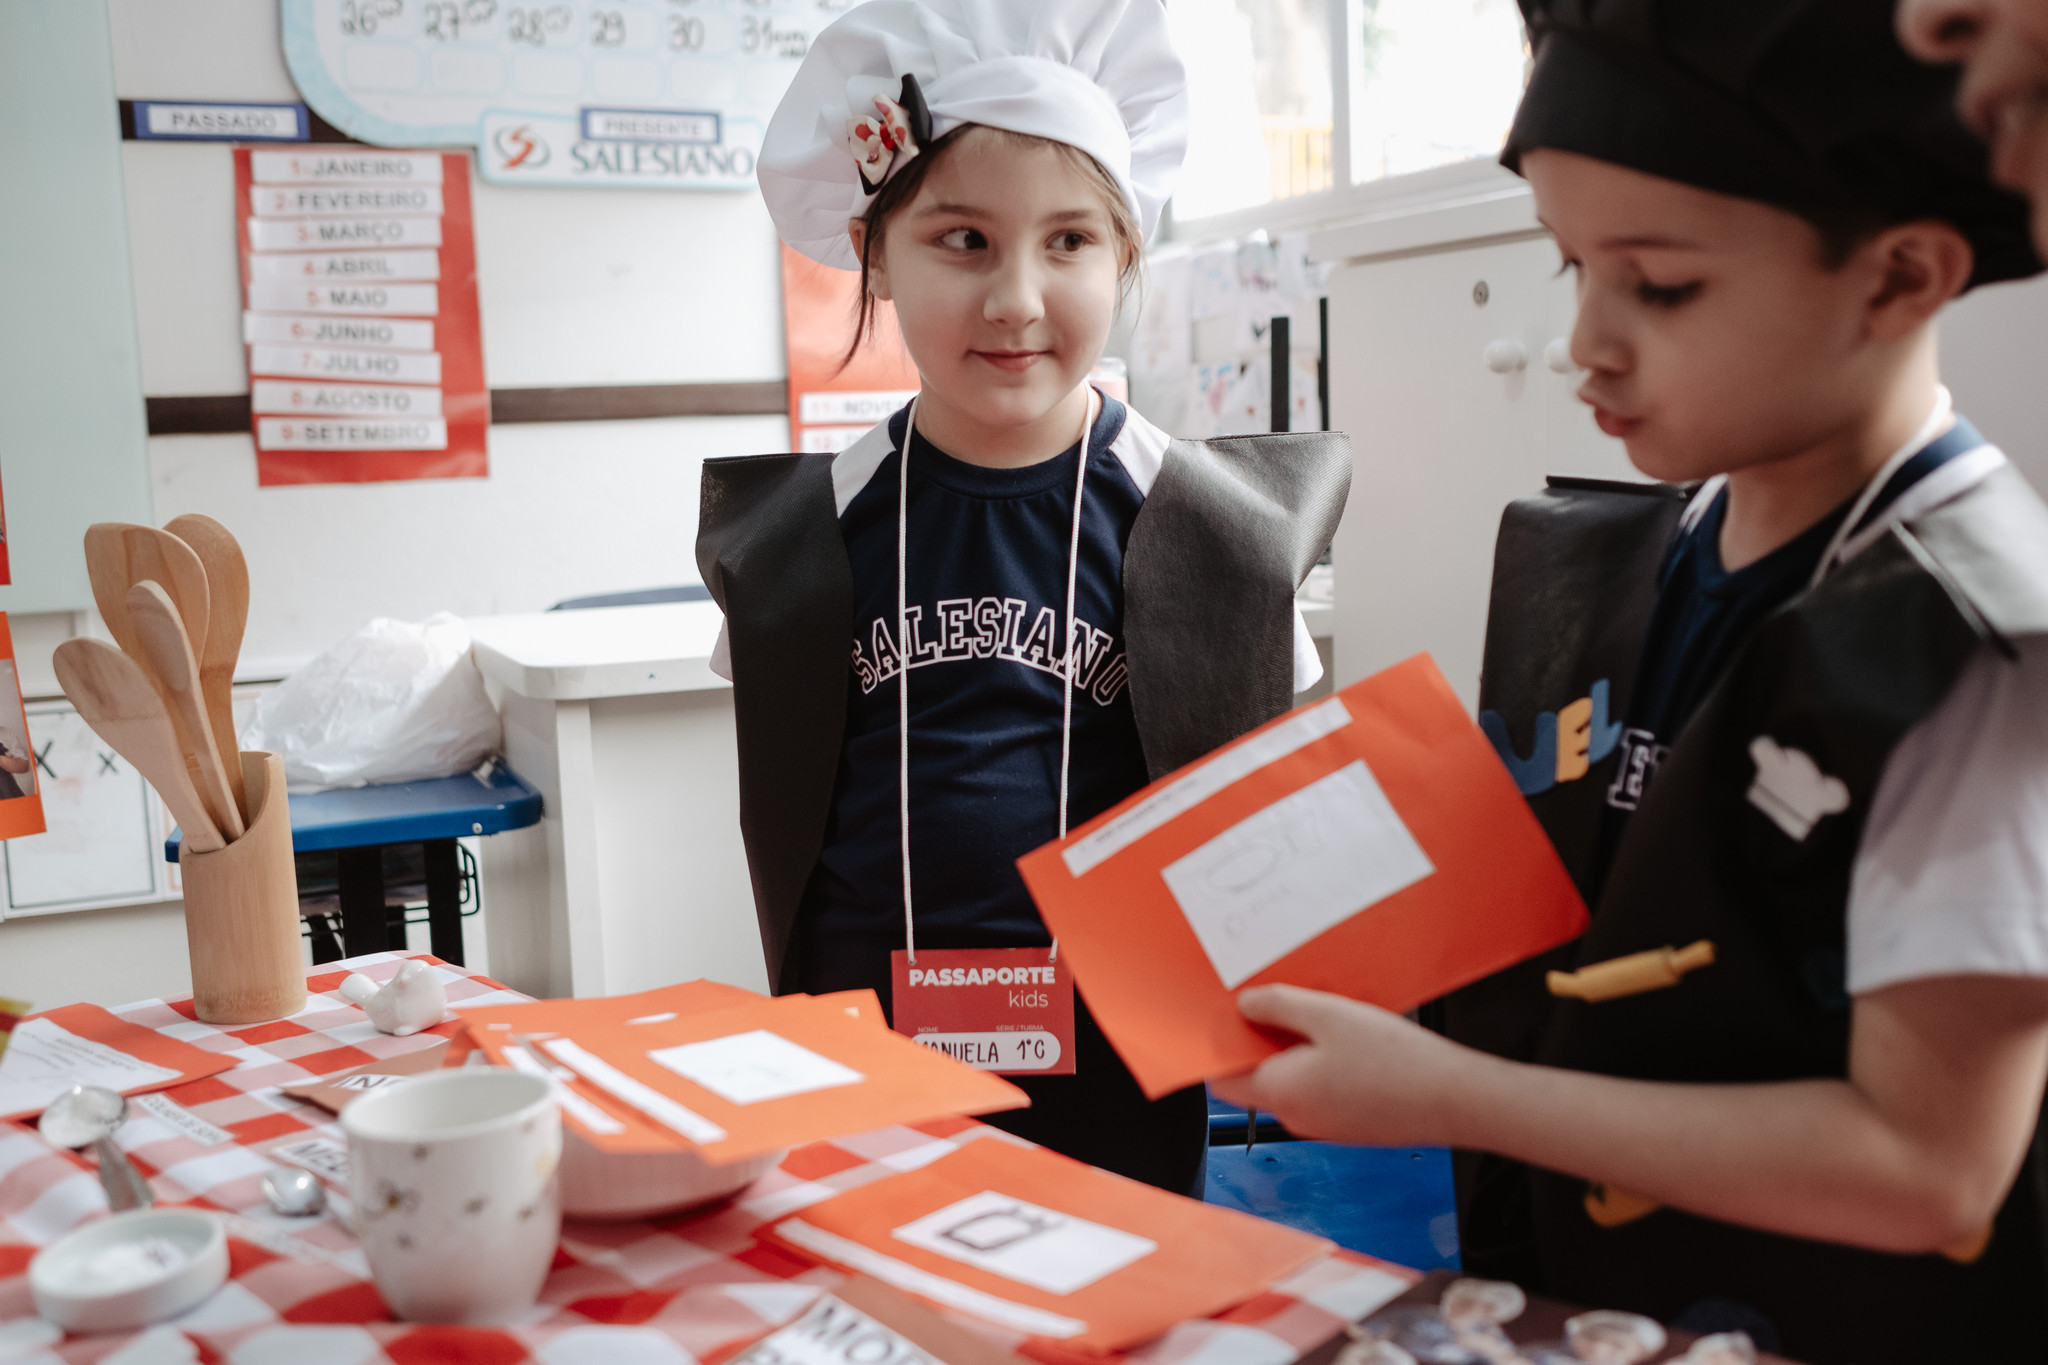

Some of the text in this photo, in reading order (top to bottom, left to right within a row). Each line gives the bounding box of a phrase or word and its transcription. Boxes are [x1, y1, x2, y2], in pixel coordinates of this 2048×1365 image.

[171, 113, 277, 130] PASSADO
[604, 113, 702, 135] PRESENTE
[571, 143, 755, 177] SALESIANO
[851, 597, 1129, 706] SALESIANO
[909, 966, 1056, 987] PASSAPORTE
[1008, 989, 1049, 1008] kids
[922, 1041, 999, 1063] NUELA
